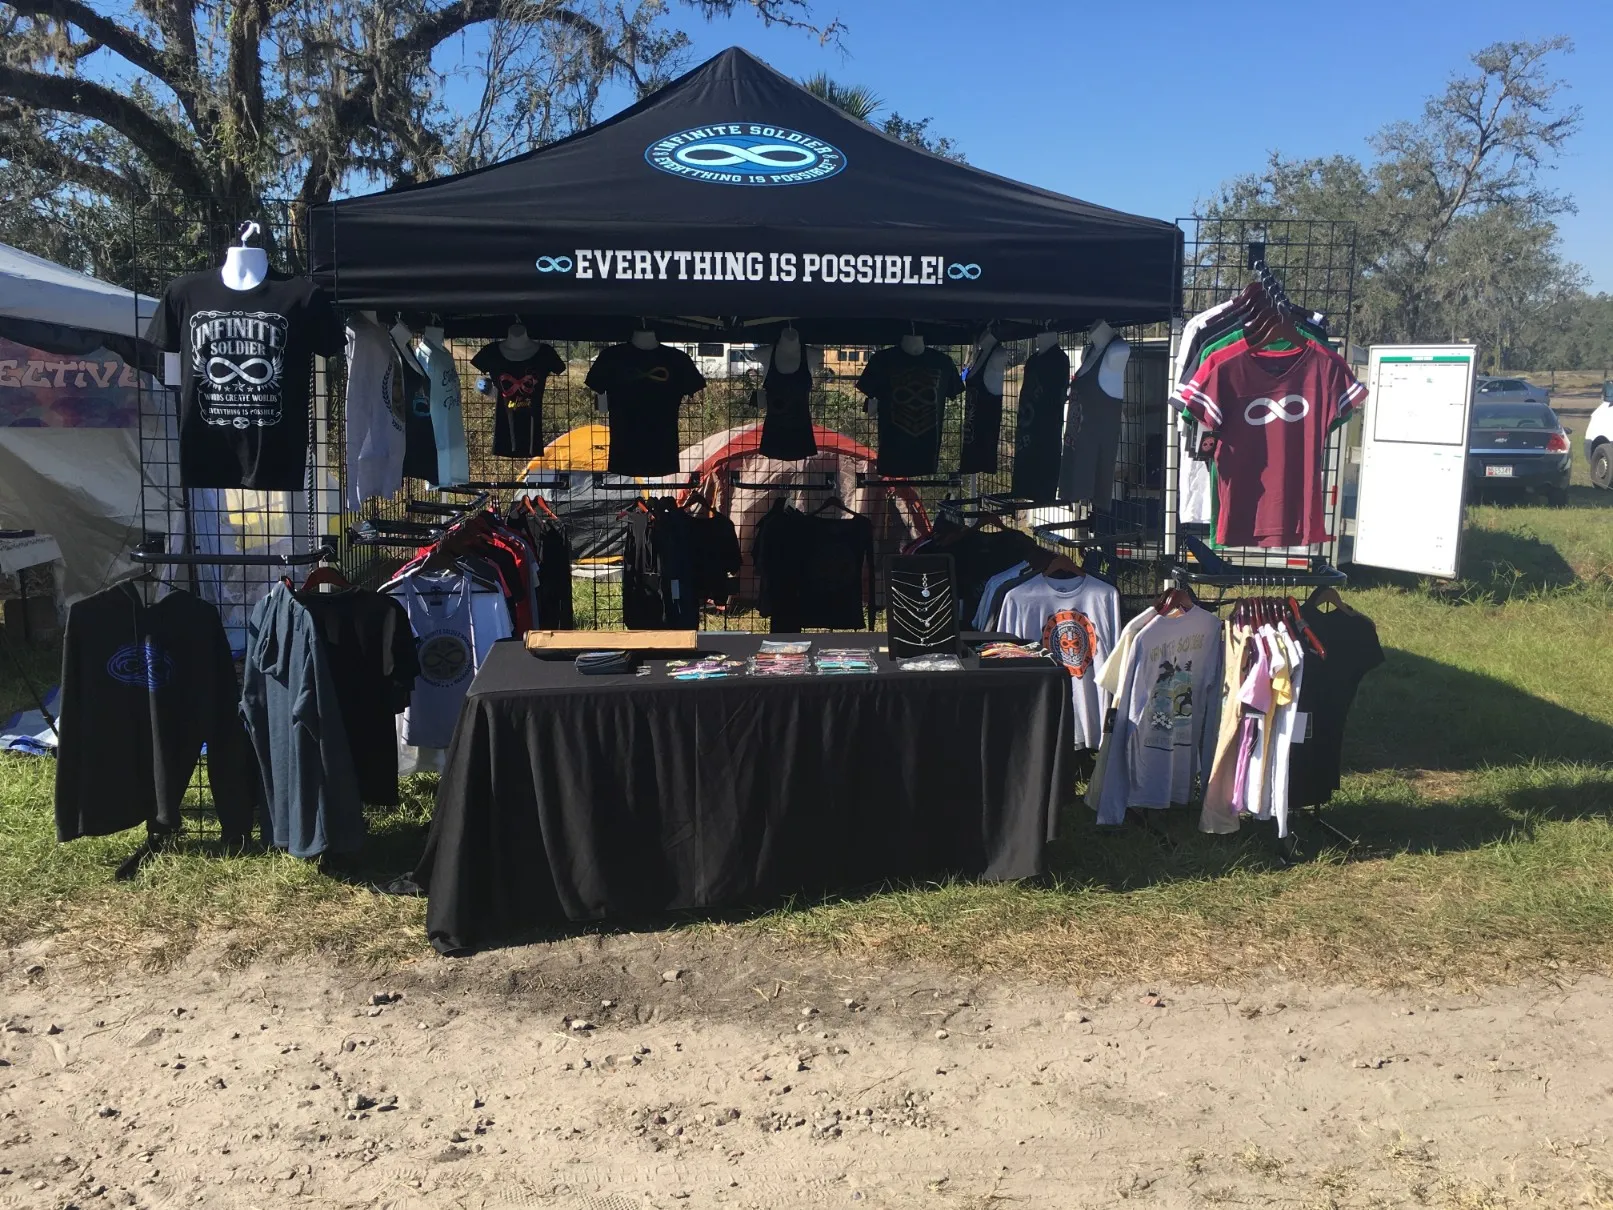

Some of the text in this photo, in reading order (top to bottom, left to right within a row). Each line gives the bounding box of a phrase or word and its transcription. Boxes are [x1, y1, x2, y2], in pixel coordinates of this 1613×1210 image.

[654, 125, 833, 154] INFINITE SOLDIER
[654, 157, 742, 182] EVERYTHING
[749, 175, 766, 183] IS
[575, 249, 944, 285] EVERYTHING IS POSSIBLE!
[195, 317, 282, 351] INFINITE
[210, 341, 266, 355] SOLDIER
[208, 407, 241, 415] EVERYTHING
[225, 393, 251, 402] CREATE
[251, 393, 278, 403] WORLDS
